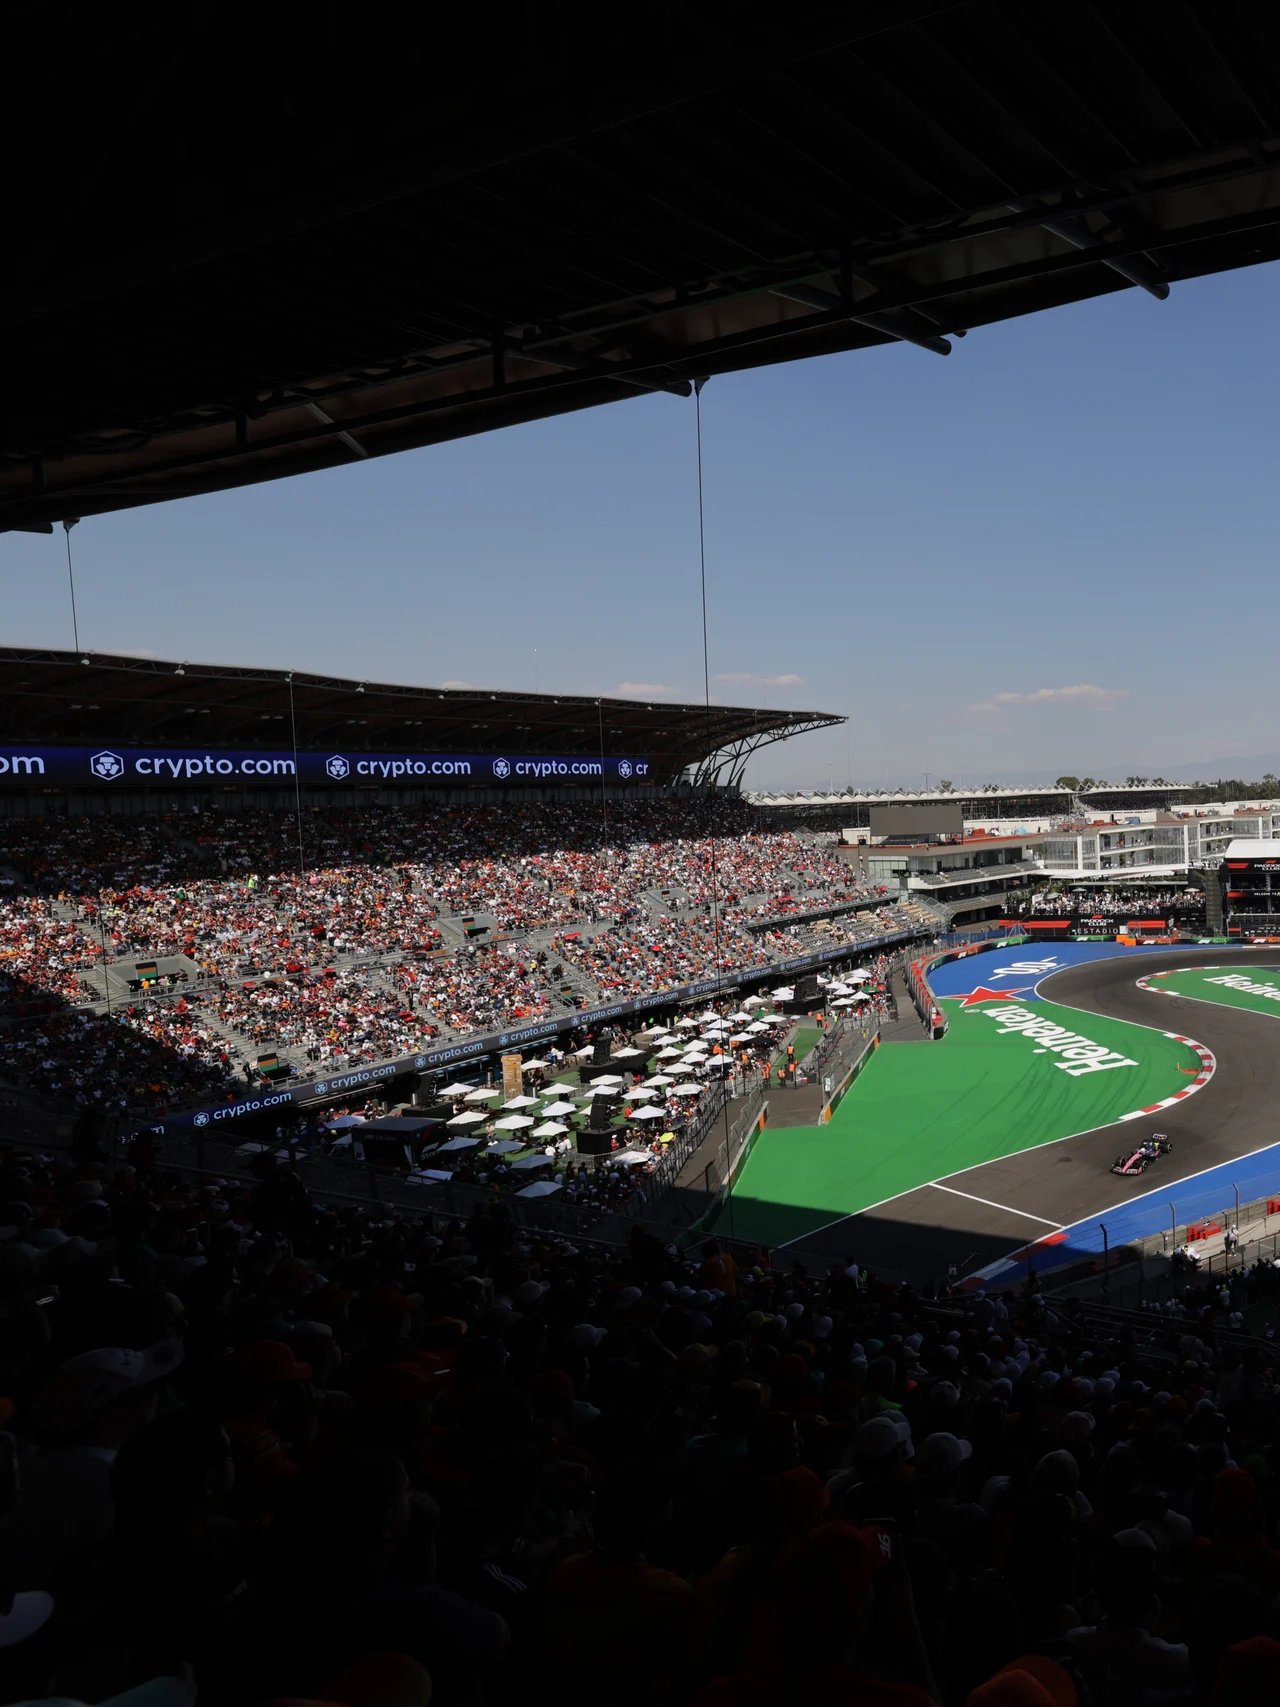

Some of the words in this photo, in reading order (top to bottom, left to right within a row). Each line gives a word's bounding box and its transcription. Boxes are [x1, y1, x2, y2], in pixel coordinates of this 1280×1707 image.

[136, 756, 296, 778] crypto.com
[357, 759, 470, 778] crypto.com
[516, 760, 602, 777] crypto.com
[636, 764, 648, 774] cr
[824, 948, 847, 959] crypto.com
[786, 957, 812, 970] crypto.com
[744, 966, 772, 980] crypto.com
[696, 978, 728, 993] crypto.com
[642, 990, 678, 1006] crypto.com
[581, 1006, 622, 1023] crypto.com
[510, 1022, 557, 1041] crypto.com
[982, 1005, 1139, 1076] Heineken
[428, 1041, 483, 1063] crypto.com
[331, 1064, 396, 1089] crypto.com
[213, 1092, 292, 1120] crypto.com
[421, 1150, 442, 1161] Stor
